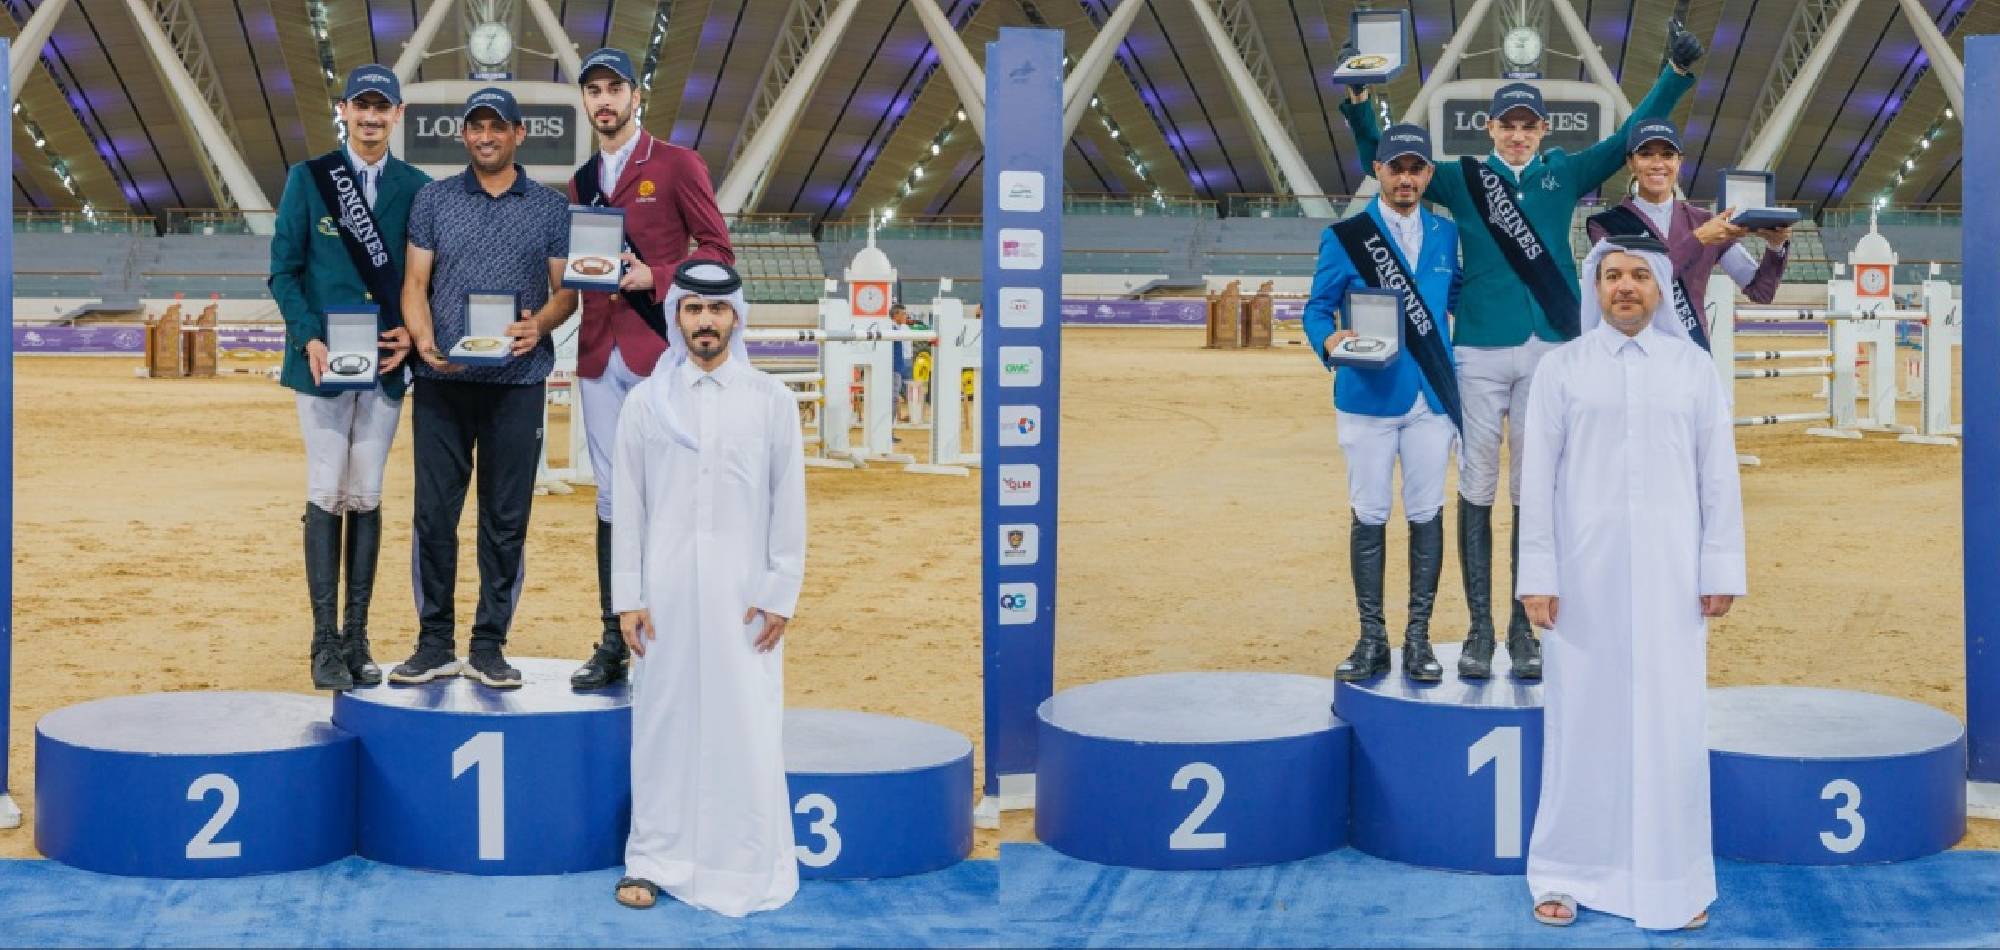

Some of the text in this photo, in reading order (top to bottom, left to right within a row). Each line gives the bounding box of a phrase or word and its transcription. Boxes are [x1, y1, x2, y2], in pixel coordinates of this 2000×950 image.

[329, 165, 388, 267] LONGINES
[1479, 168, 1543, 260] LONGINES
[185, 773, 241, 859] 2
[452, 731, 505, 861] 1
[795, 793, 842, 868] 3
[1169, 761, 1227, 850] 2
[1467, 726, 1523, 858] 1
[1819, 779, 1866, 853] 3
